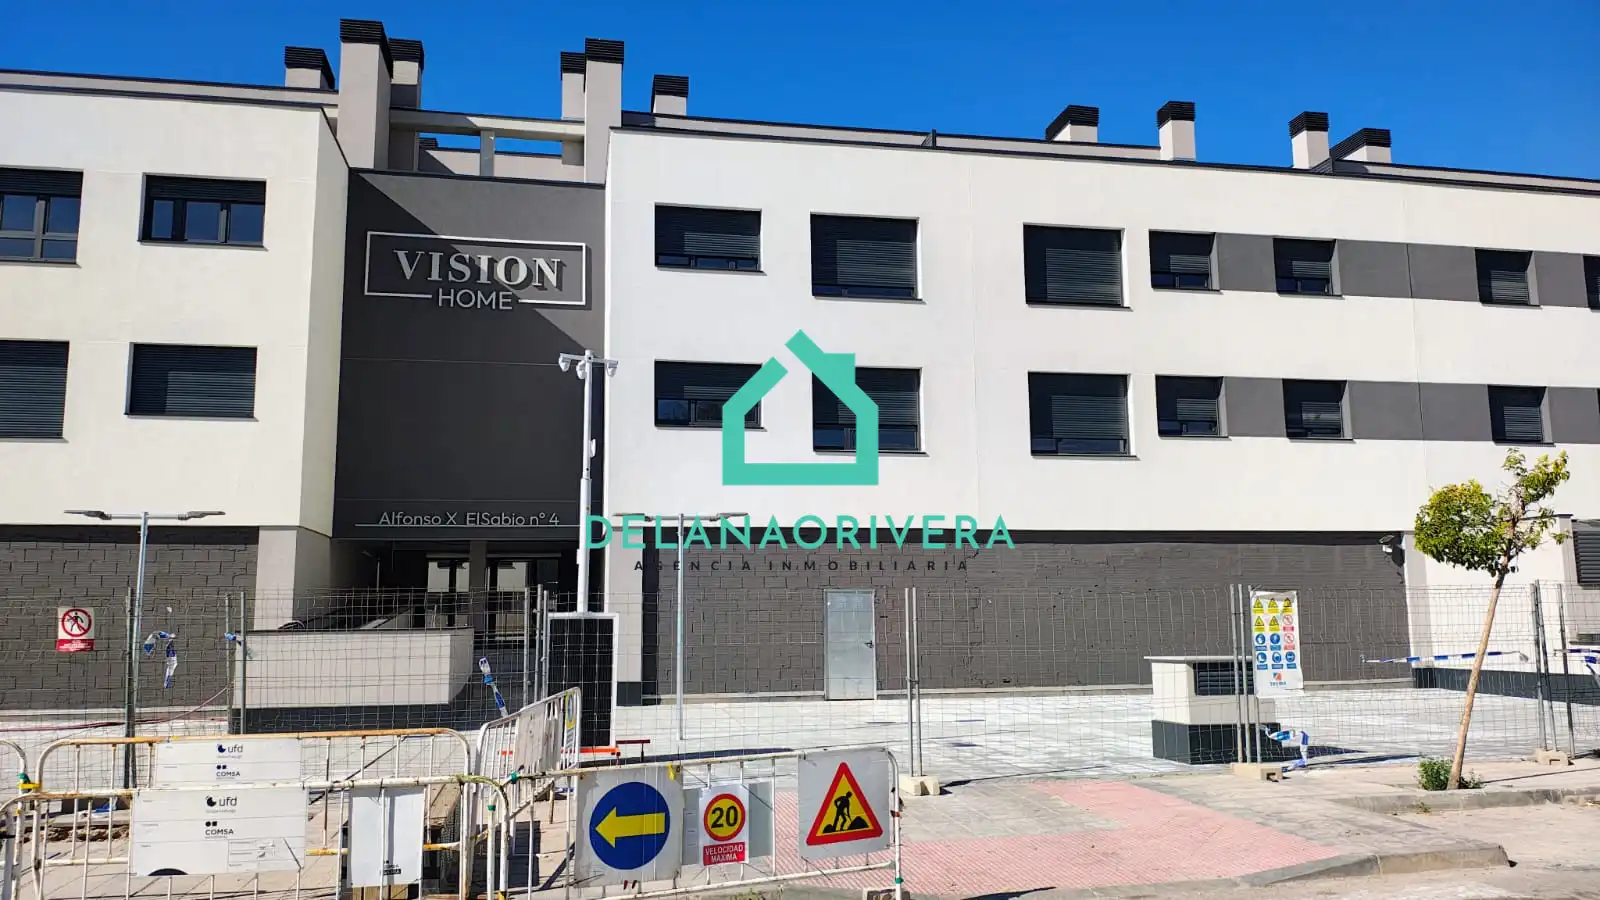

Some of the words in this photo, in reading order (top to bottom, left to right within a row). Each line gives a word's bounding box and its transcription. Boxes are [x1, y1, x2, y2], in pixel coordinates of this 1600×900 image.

[394, 249, 561, 288] VISION
[438, 288, 513, 310] HOME
[379, 512, 442, 525] Alfonso
[446, 512, 458, 525] X
[548, 512, 560, 526] 4
[227, 744, 244, 753] ufd
[218, 796, 238, 807] ufd
[711, 805, 739, 829] 20
[705, 844, 744, 855] VELOCIDAD
